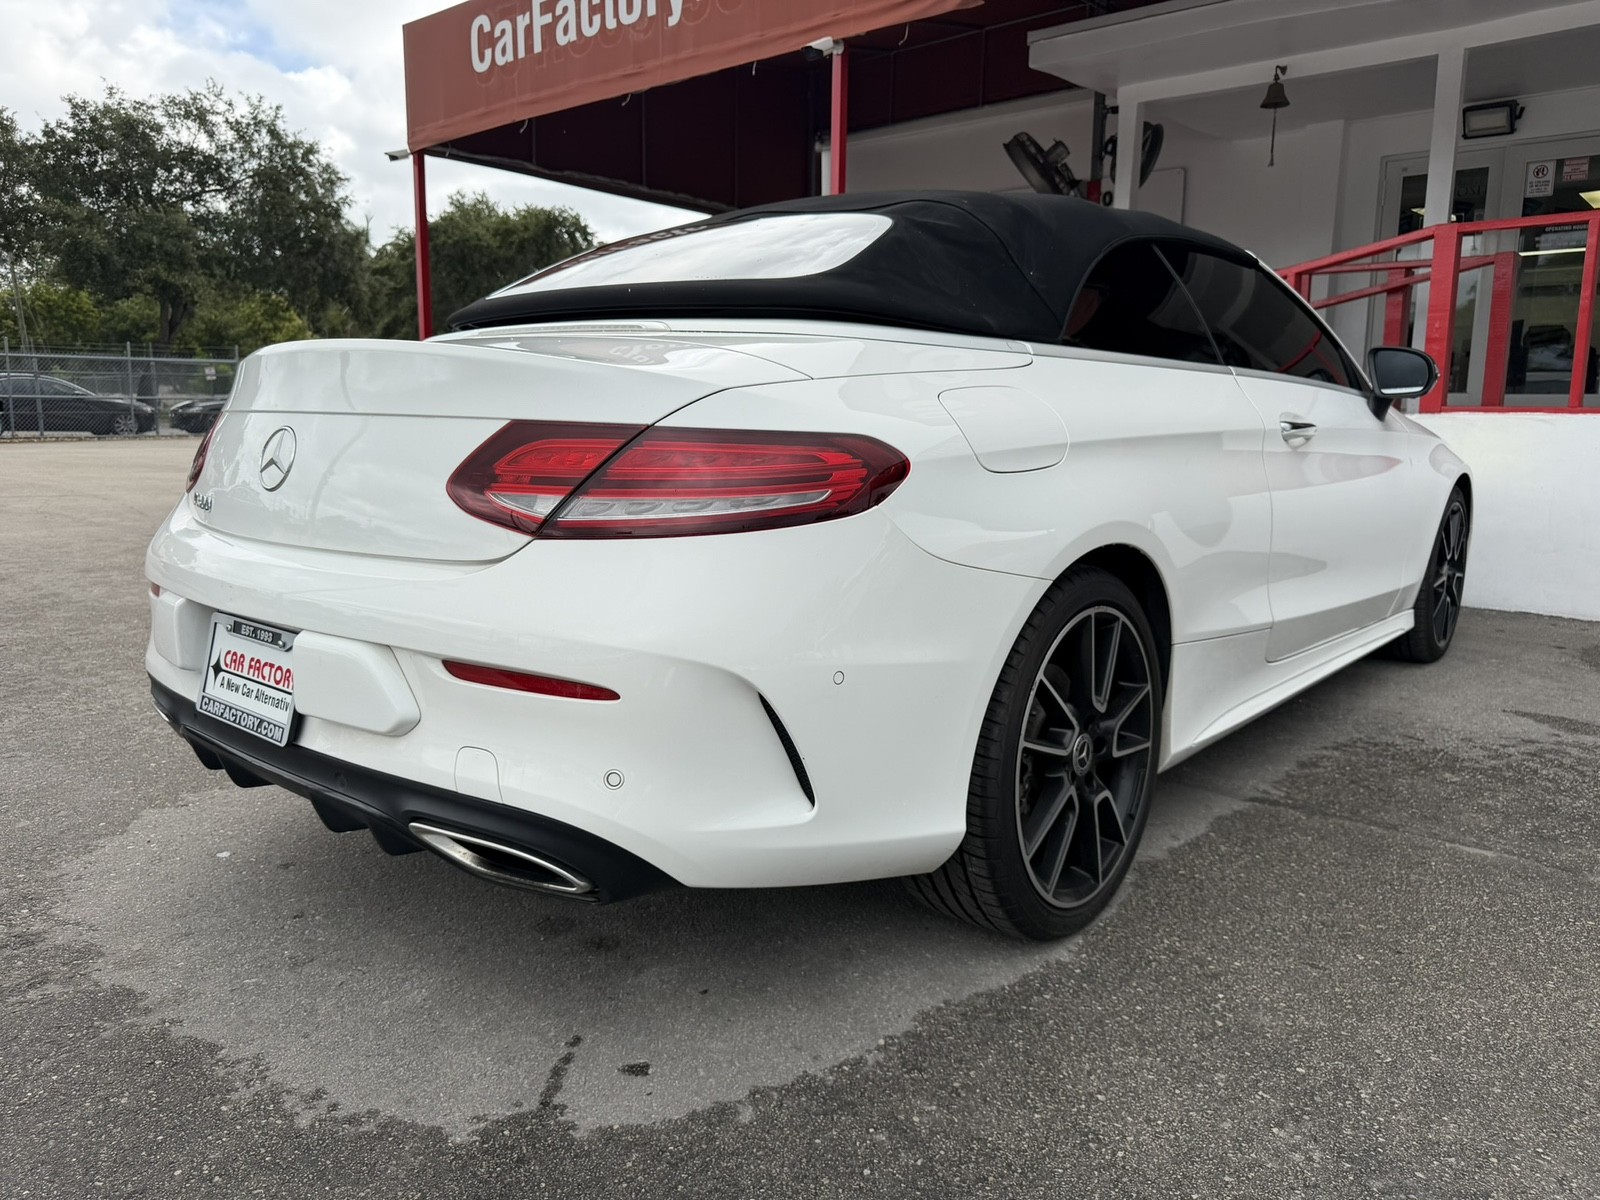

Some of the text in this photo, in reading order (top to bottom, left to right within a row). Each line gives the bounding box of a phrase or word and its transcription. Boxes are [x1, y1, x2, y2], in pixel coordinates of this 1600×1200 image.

[241, 624, 273, 643] EST. 1993
[224, 650, 246, 674] CAR
[219, 676, 226, 689] A
[226, 678, 241, 694] New
[241, 683, 254, 699] Car
[201, 697, 285, 742] CARFACTORY.COM
